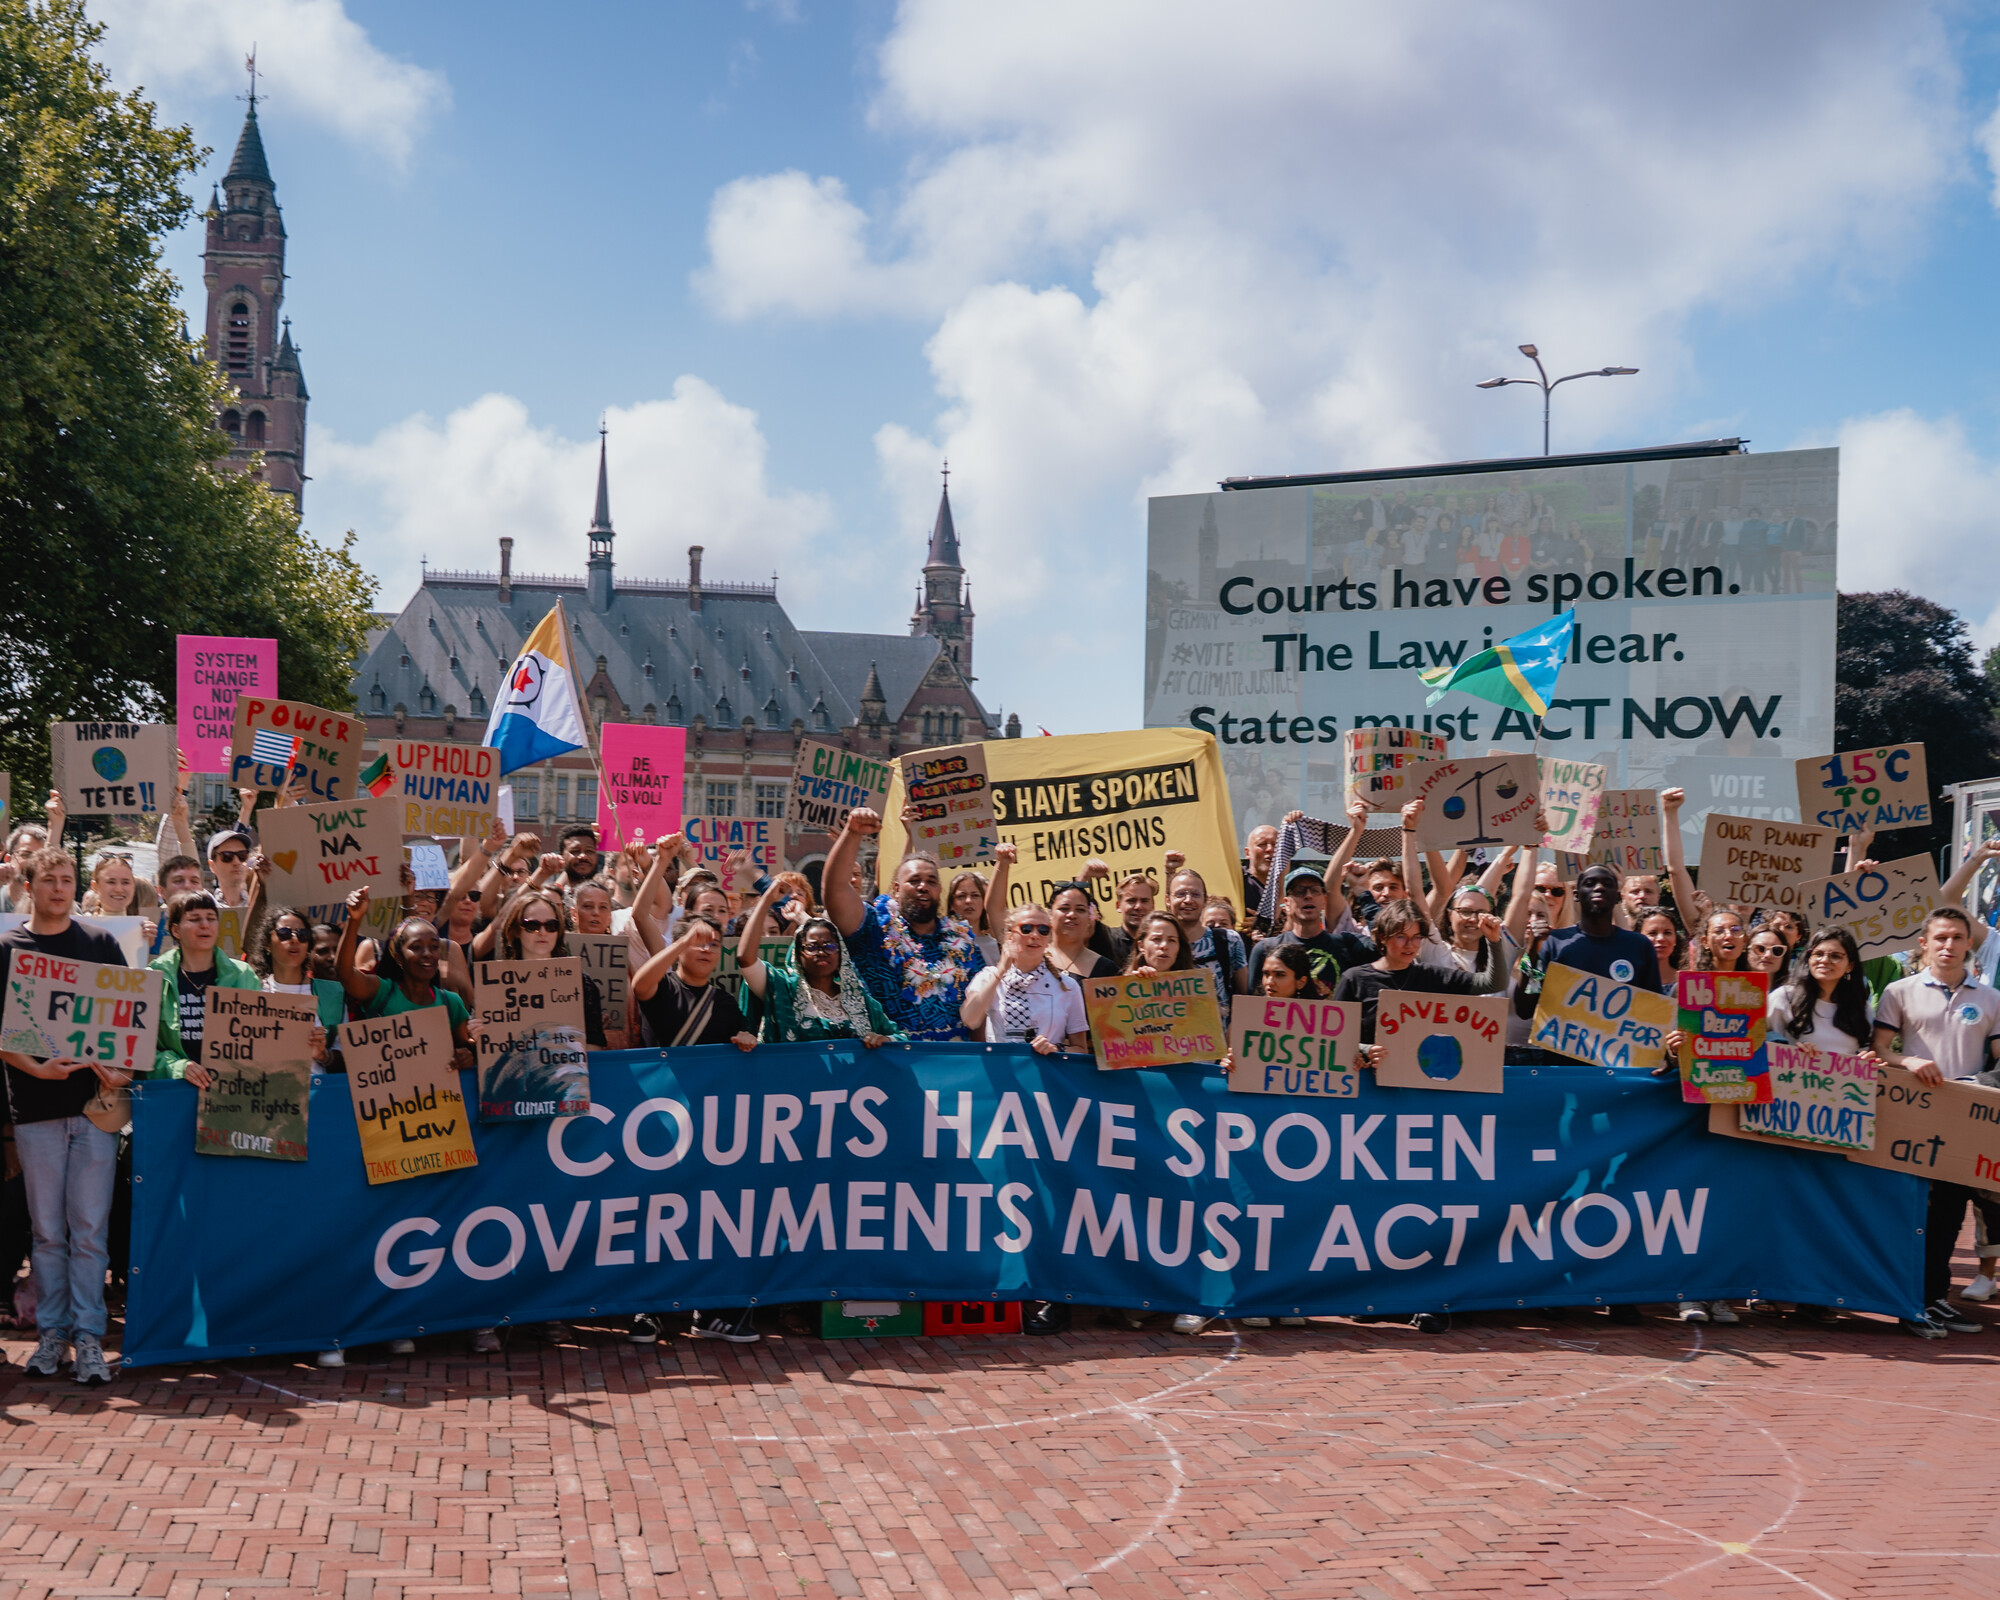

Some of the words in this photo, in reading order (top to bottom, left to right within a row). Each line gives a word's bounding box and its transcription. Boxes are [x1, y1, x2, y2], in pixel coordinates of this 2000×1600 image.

[1219, 576, 1378, 615] Courts
[1393, 569, 1511, 608] have
[1527, 557, 1741, 615] spoken.
[195, 652, 258, 669] SYSTEM
[1262, 633, 1353, 672] The
[1369, 630, 1469, 669] Law
[1563, 623, 1685, 664] lear.
[194, 670, 259, 686] CHANGE
[246, 701, 349, 742] POWER
[1190, 706, 1337, 744] States
[1491, 698, 1611, 741] ACT
[1622, 695, 1783, 740] NOW.
[303, 741, 340, 766] THE
[397, 744, 492, 778] UPHOLD
[633, 757, 650, 771] DE
[233, 755, 340, 801] PEOPLE
[611, 772, 670, 789] KLIMAAT
[925, 760, 965, 776] WHERE
[404, 774, 490, 804] HUMAN
[798, 775, 869, 807] JUSTICE
[1014, 782, 1083, 818] HAVE
[1090, 766, 1195, 811] SPOKEN
[1370, 775, 1404, 791] NAO
[1416, 763, 1459, 802] LIMATE
[1709, 774, 1766, 799] VOTE
[617, 790, 629, 804] IS
[632, 791, 662, 805] VOL!
[1546, 788, 1581, 805] the
[1834, 786, 1881, 808] TO
[309, 808, 368, 833] YUMI
[798, 799, 837, 826] YUMI
[915, 805, 944, 818] HAVE
[1491, 793, 1537, 827] JUSTICE!
[1817, 809, 1870, 833] STAY
[918, 823, 959, 839] COURTS
[1034, 816, 1166, 861] EMISSIONS
[1717, 822, 1752, 841] OUR
[1764, 827, 1823, 849] PLANET
[321, 833, 362, 857] NA
[938, 841, 973, 860] NOT
[318, 856, 381, 884] YUMI
[1728, 847, 1803, 874] DEPENDS
[1742, 871, 1759, 882] ON
[1763, 872, 1780, 884] THE
[1727, 881, 1802, 910] ICJAO!
[1824, 872, 1889, 918] AO
[16, 954, 79, 984] SAVE
[96, 968, 147, 993] OUR
[482, 964, 531, 985] Law
[538, 967, 549, 979] of
[555, 968, 573, 977] the
[505, 988, 544, 1008] Sea
[551, 987, 580, 1003] Court
[1095, 986, 1117, 999] NO
[1126, 977, 1208, 998] CLIMATE
[1568, 977, 1632, 1019] AO
[48, 991, 147, 1029] FUTUR
[212, 992, 315, 1022] InterAmerican
[482, 1007, 520, 1024] said
[1116, 1002, 1187, 1023] JUSTICE
[1264, 1001, 1344, 1036] END
[230, 1017, 284, 1040] Court
[347, 1016, 412, 1047] World
[1133, 1023, 1174, 1036] WITHOUT
[1380, 1001, 1448, 1035] SAVE
[1455, 1006, 1499, 1043] OUR
[1618, 1020, 1662, 1047] FOR
[1703, 1010, 1745, 1034] DELAY.
[66, 1030, 138, 1067] 1.5!
[210, 1039, 253, 1060] said
[382, 1037, 427, 1061] Court
[481, 1029, 538, 1054] Protect
[552, 1033, 575, 1045] the
[1103, 1039, 1154, 1061] HUMAN
[1163, 1035, 1216, 1056] RIGHTS
[1537, 1017, 1629, 1067] AFRICA
[1694, 1037, 1752, 1057] CLIMATE
[540, 1048, 586, 1065] Ocean
[1822, 1051, 1878, 1080] JUSTICE
[205, 1068, 268, 1097] Protect
[358, 1062, 396, 1088] said
[1264, 1066, 1354, 1095] FUELS
[1692, 1062, 1742, 1083] JUSTICE
[1777, 1071, 1796, 1083] at
[1799, 1071, 1836, 1092] the
[1707, 1086, 1753, 1100] TODAY
[204, 1097, 241, 1113] Human
[251, 1099, 300, 1121] Rights
[360, 1083, 437, 1130] Uphold
[442, 1090, 461, 1103] the
[481, 1101, 514, 1116] TAKE
[515, 1101, 556, 1116] CLIMATE
[558, 1100, 590, 1112] ACTION
[400, 1119, 456, 1142] Law
[1744, 1098, 1801, 1132] WORLD
[1807, 1104, 1875, 1143] COURT
[200, 1127, 230, 1147] TAKE
[231, 1131, 273, 1153] CLIMATE
[547, 1086, 889, 1177] COURTS
[922, 1089, 1137, 1170] HAVE
[1164, 1108, 1496, 1182] SPOKEN
[1531, 1148, 1557, 1162] -
[367, 1160, 399, 1178] TAKE
[401, 1152, 441, 1174] CLIMATE
[445, 1150, 477, 1167] ACTION
[1890, 1135, 1946, 1167] act
[373, 1181, 1034, 1290] GOVERNMENTS
[1061, 1188, 1285, 1272] MUST
[1308, 1203, 1479, 1272] ACT
[1498, 1187, 1710, 1264] NOW
